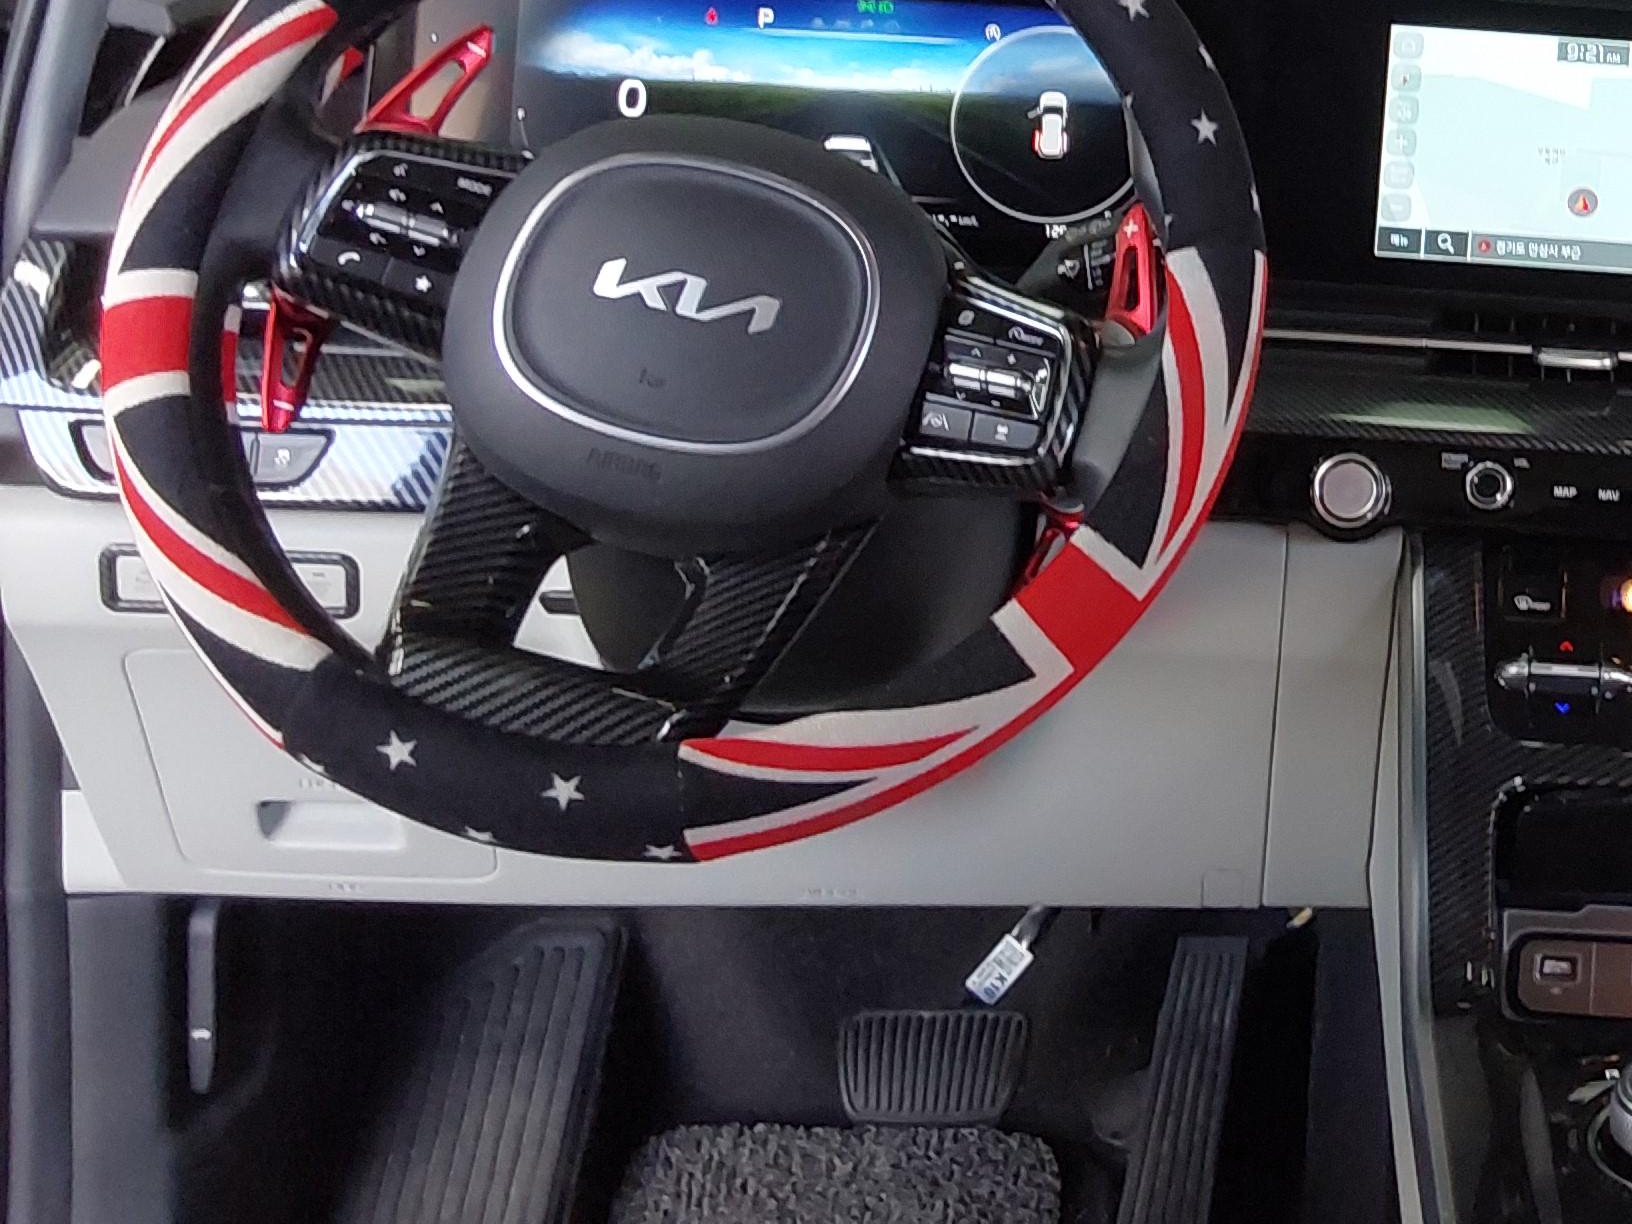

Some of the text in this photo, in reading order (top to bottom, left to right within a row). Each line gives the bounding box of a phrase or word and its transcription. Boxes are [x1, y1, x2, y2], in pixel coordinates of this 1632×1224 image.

[758, 7, 774, 29] P
[1553, 485, 1578, 498] MAP
[1598, 488, 1620, 502] NAV
